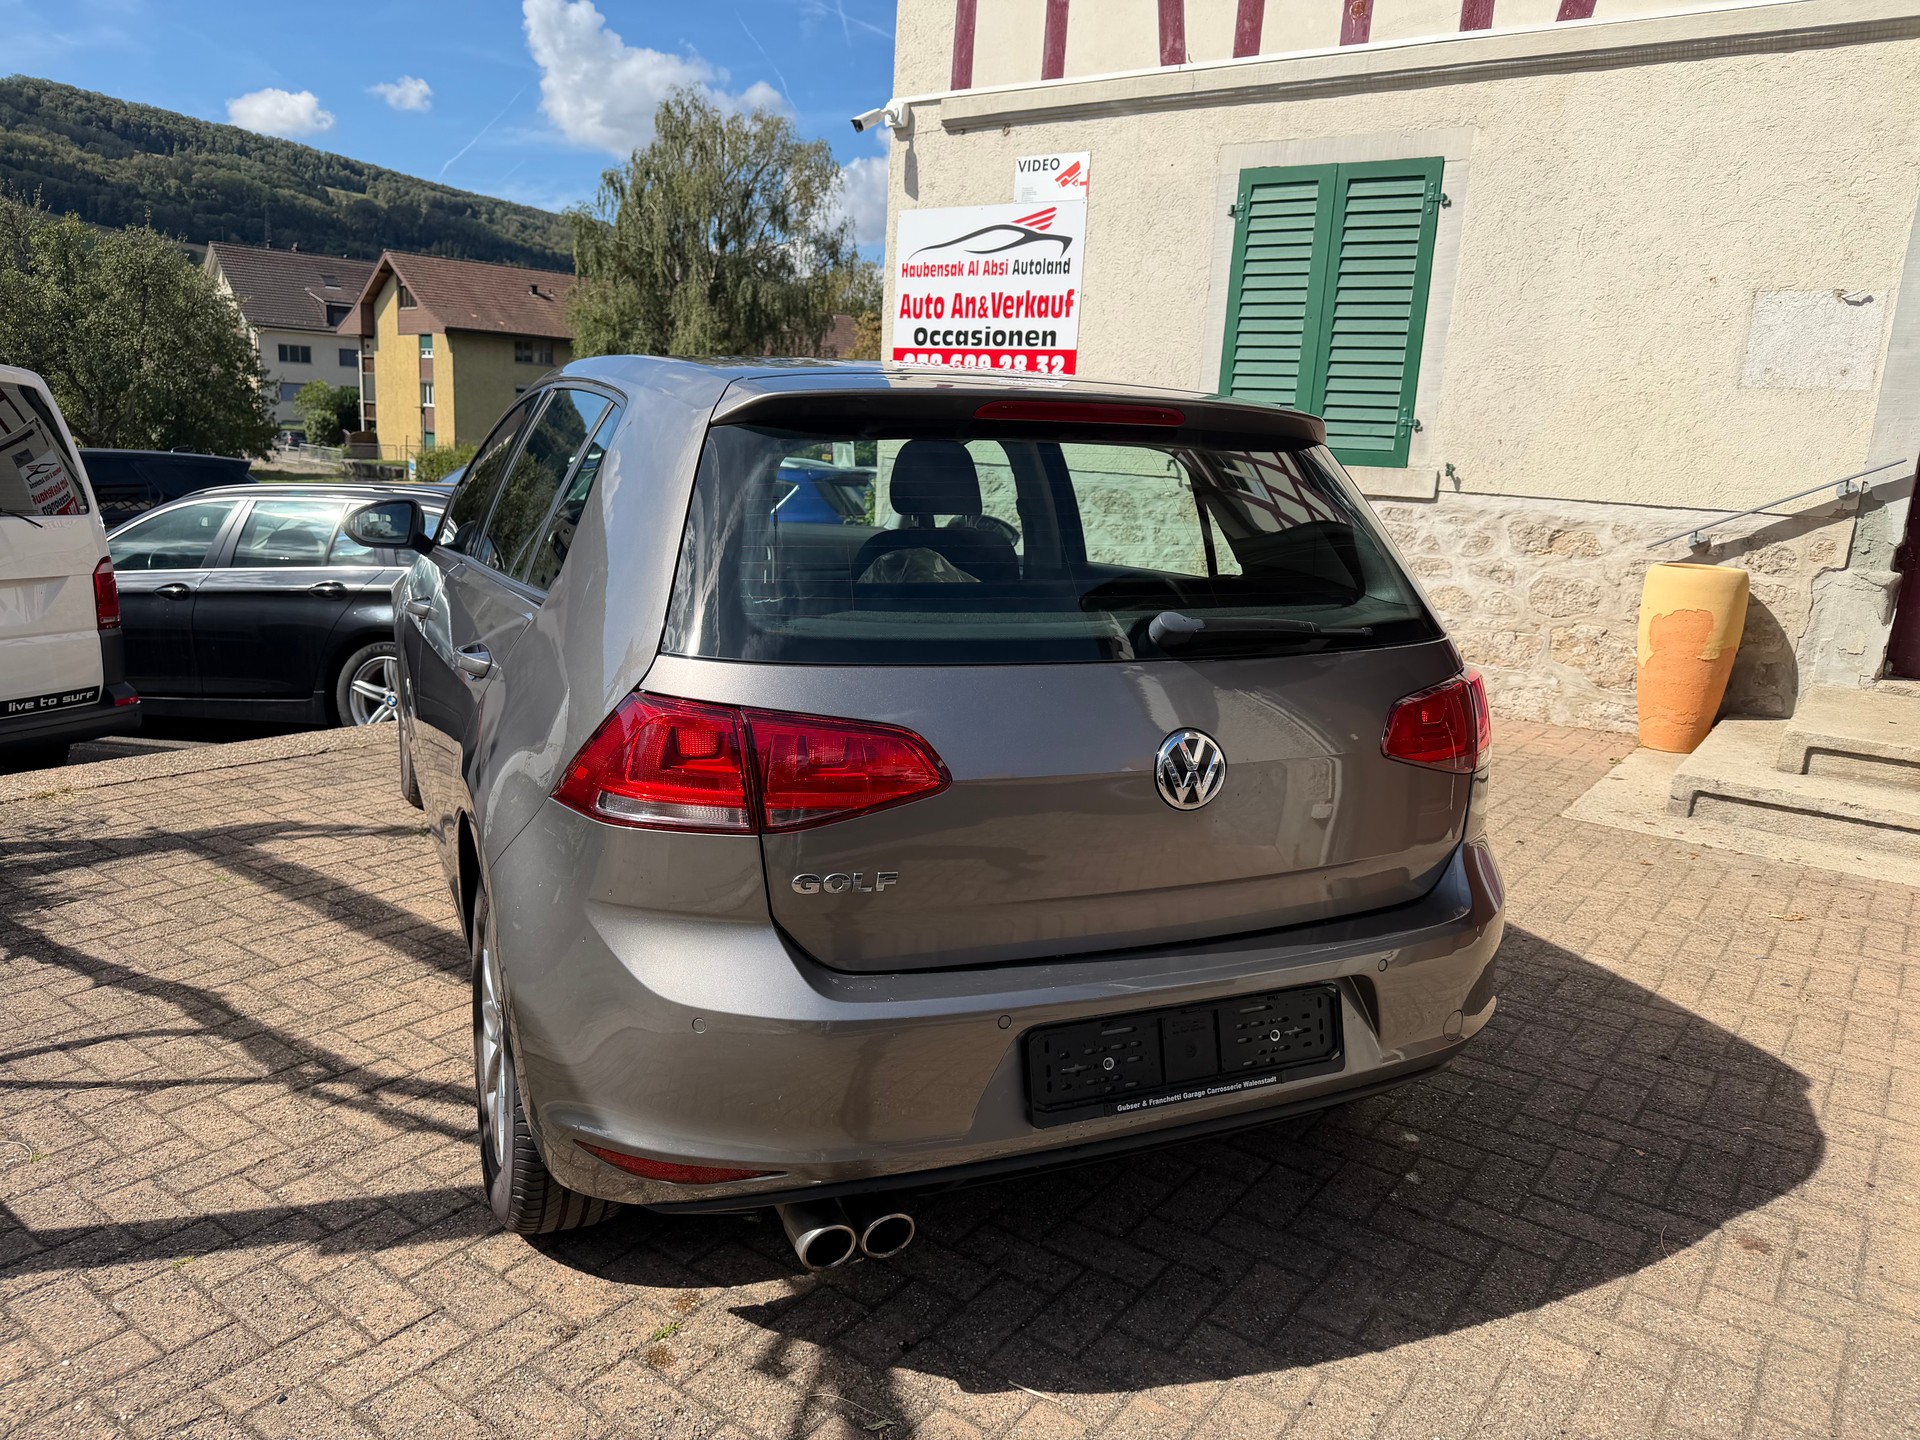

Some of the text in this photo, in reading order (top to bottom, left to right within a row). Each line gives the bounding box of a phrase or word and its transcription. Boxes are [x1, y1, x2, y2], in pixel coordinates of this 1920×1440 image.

[1018, 158, 1060, 173] VIDEO
[902, 257, 1071, 278] Haubensak Al Absi Autoland
[899, 288, 1075, 319] Auto An&Verkauf
[913, 326, 1057, 346] Occasionen
[999, 354, 1028, 370] 28
[1036, 354, 1065, 374] 32
[8, 691, 95, 712] live to surf
[1157, 731, 1225, 809] VW
[791, 871, 898, 895] GOLF
[1117, 1102, 1141, 1112] Gubser
[1148, 1094, 1182, 1106] Franchetti
[1183, 1089, 1206, 1100] Garage
[1206, 1083, 1242, 1095] Carrosserie
[1243, 1076, 1277, 1088] Walenstadt
